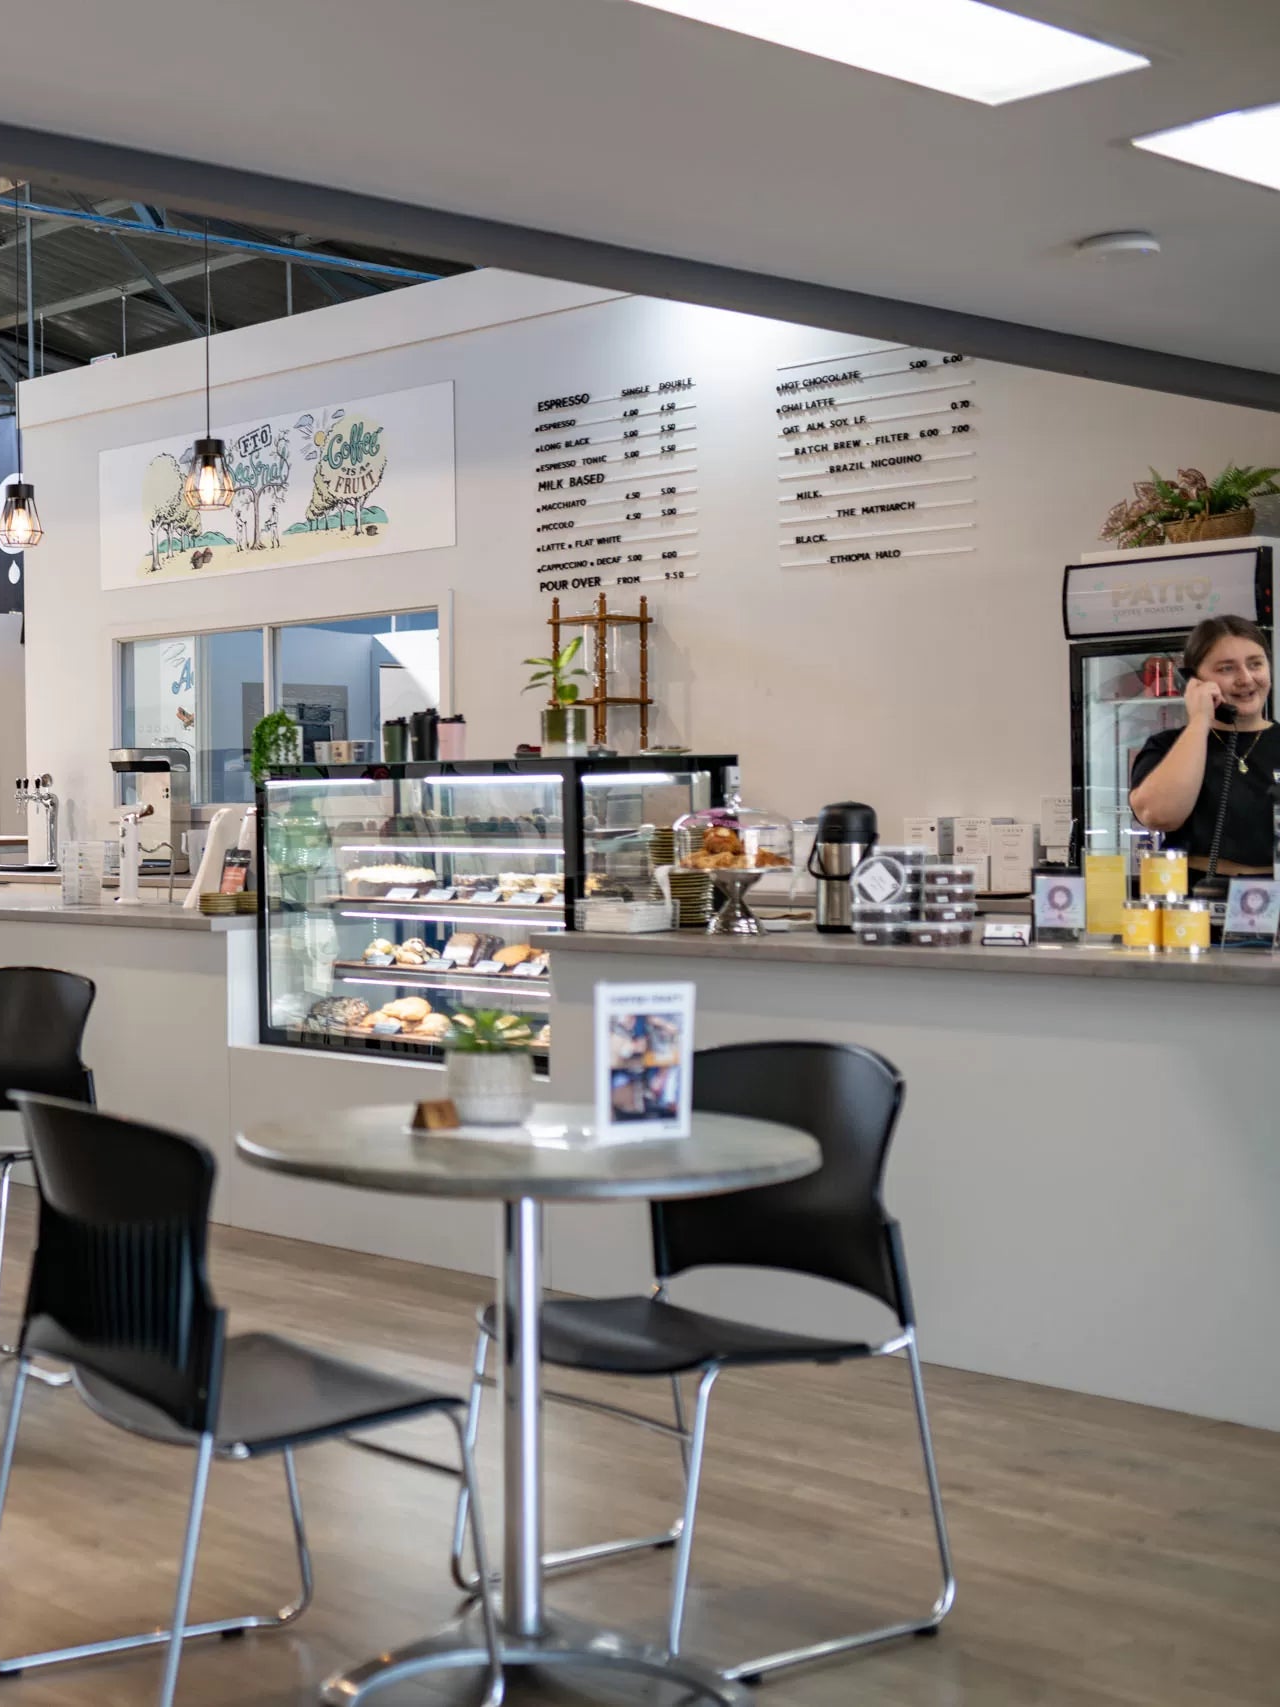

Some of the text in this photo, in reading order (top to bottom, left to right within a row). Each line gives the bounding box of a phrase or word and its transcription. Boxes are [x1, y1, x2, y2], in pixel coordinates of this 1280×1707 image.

[781, 354, 963, 390] HOT CHOCOLATE 5.00 6.00
[537, 378, 692, 411] ESPRESSO SINGLE DOUBLE
[781, 398, 834, 412] CHAI LATTE
[539, 402, 675, 431] ESPRESSO 4.00 4.50
[322, 421, 384, 470] Coffee
[540, 423, 675, 452] LONG BLACK 5.00 5.50
[794, 424, 969, 455] BATCH BREW FILTER 6.00 7.00
[540, 444, 676, 472] ESPRESSO TONIC 5.00 5.50
[829, 462, 864, 473] BRAZIL
[334, 469, 376, 495] FRUIT
[345, 467, 357, 476] IS
[538, 473, 605, 491] MILK BASED
[541, 486, 676, 511] MACCHIATO 4.50 5.00
[837, 501, 915, 517] THE MATRIARCH
[541, 507, 676, 531] PICCOLO 4.50 5.00
[541, 535, 621, 551] LATTE FLAT WHITE
[541, 560, 588, 572] CAPPUCCINO
[596, 556, 621, 565] DECAF
[627, 554, 642, 563] 5.00
[830, 549, 901, 563] ETHIOPIA HALO
[539, 579, 568, 592] POUR
[571, 576, 601, 589] OVER
[617, 576, 640, 585] FROM
